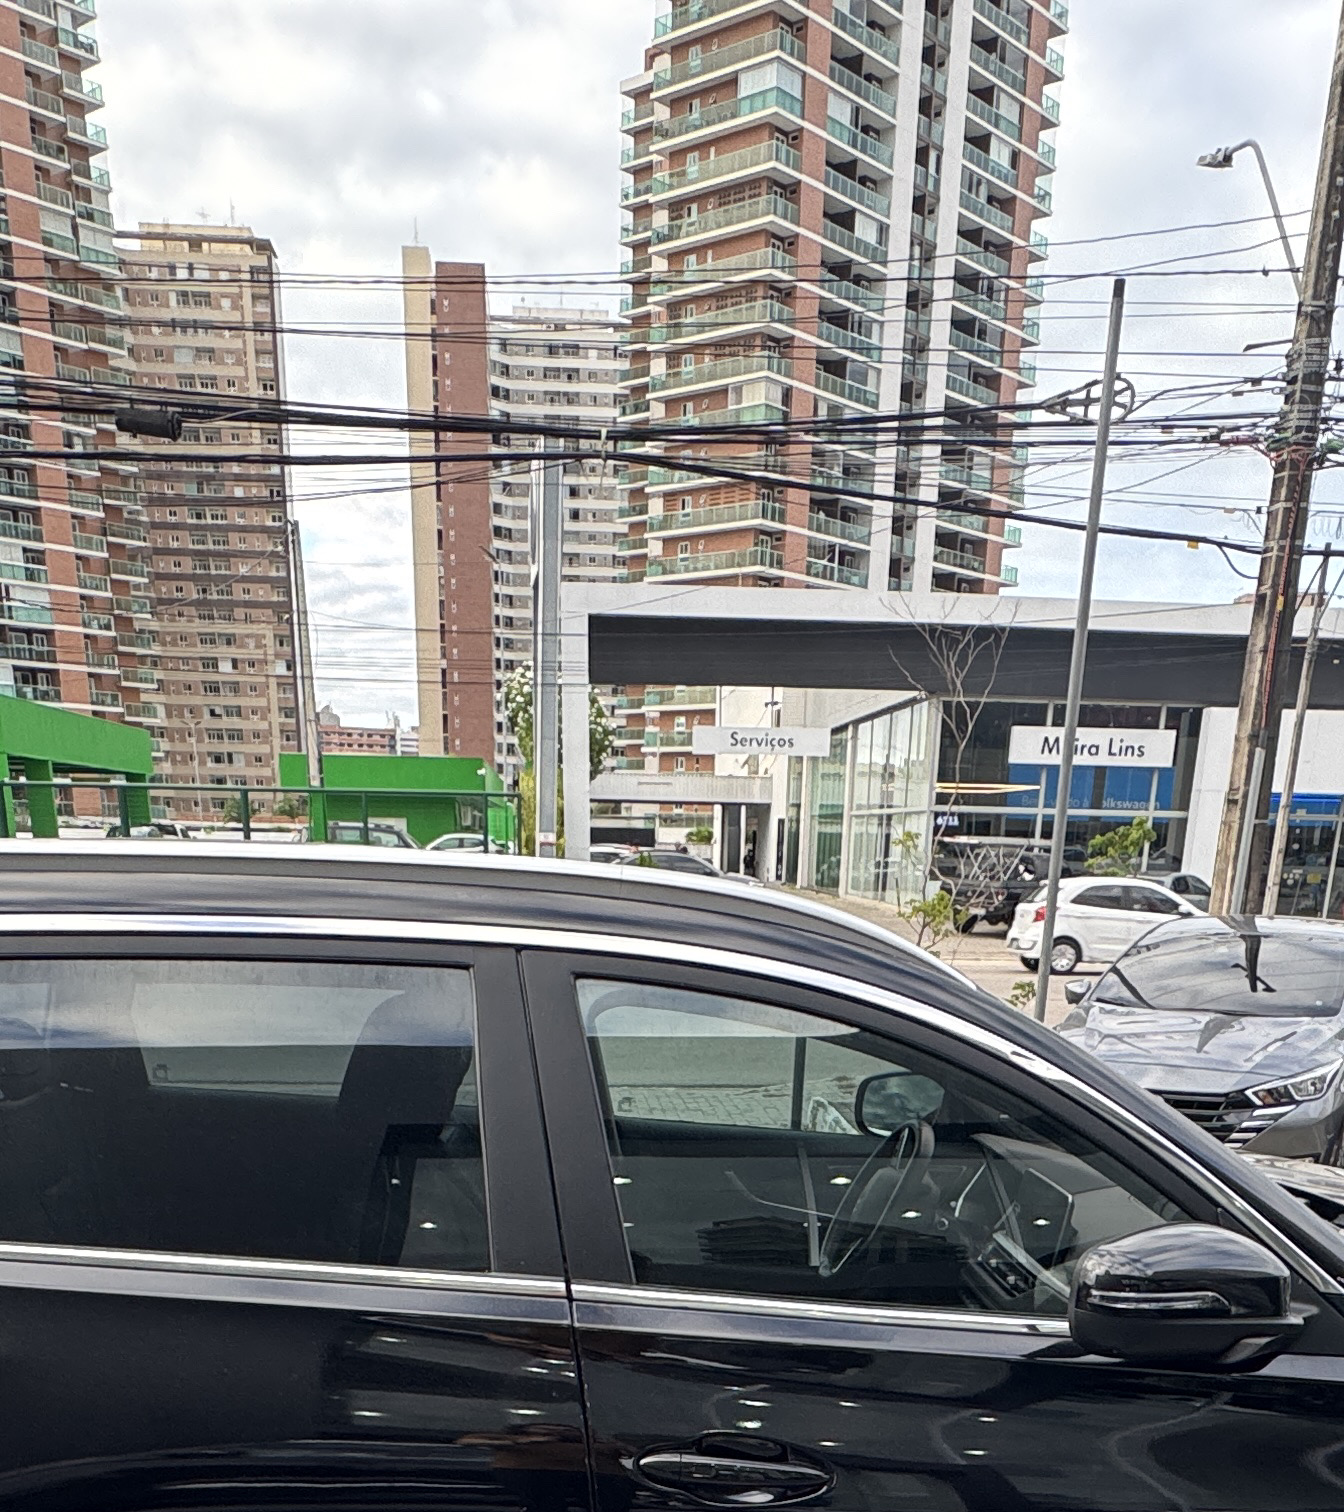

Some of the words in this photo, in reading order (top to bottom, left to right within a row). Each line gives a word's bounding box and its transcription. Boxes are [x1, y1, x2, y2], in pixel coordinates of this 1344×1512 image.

[730, 731, 795, 751] Serviços
[1040, 736, 1100, 757] Mira
[1107, 737, 1146, 758] Lins
[1101, 797, 1160, 809] olkswagn
